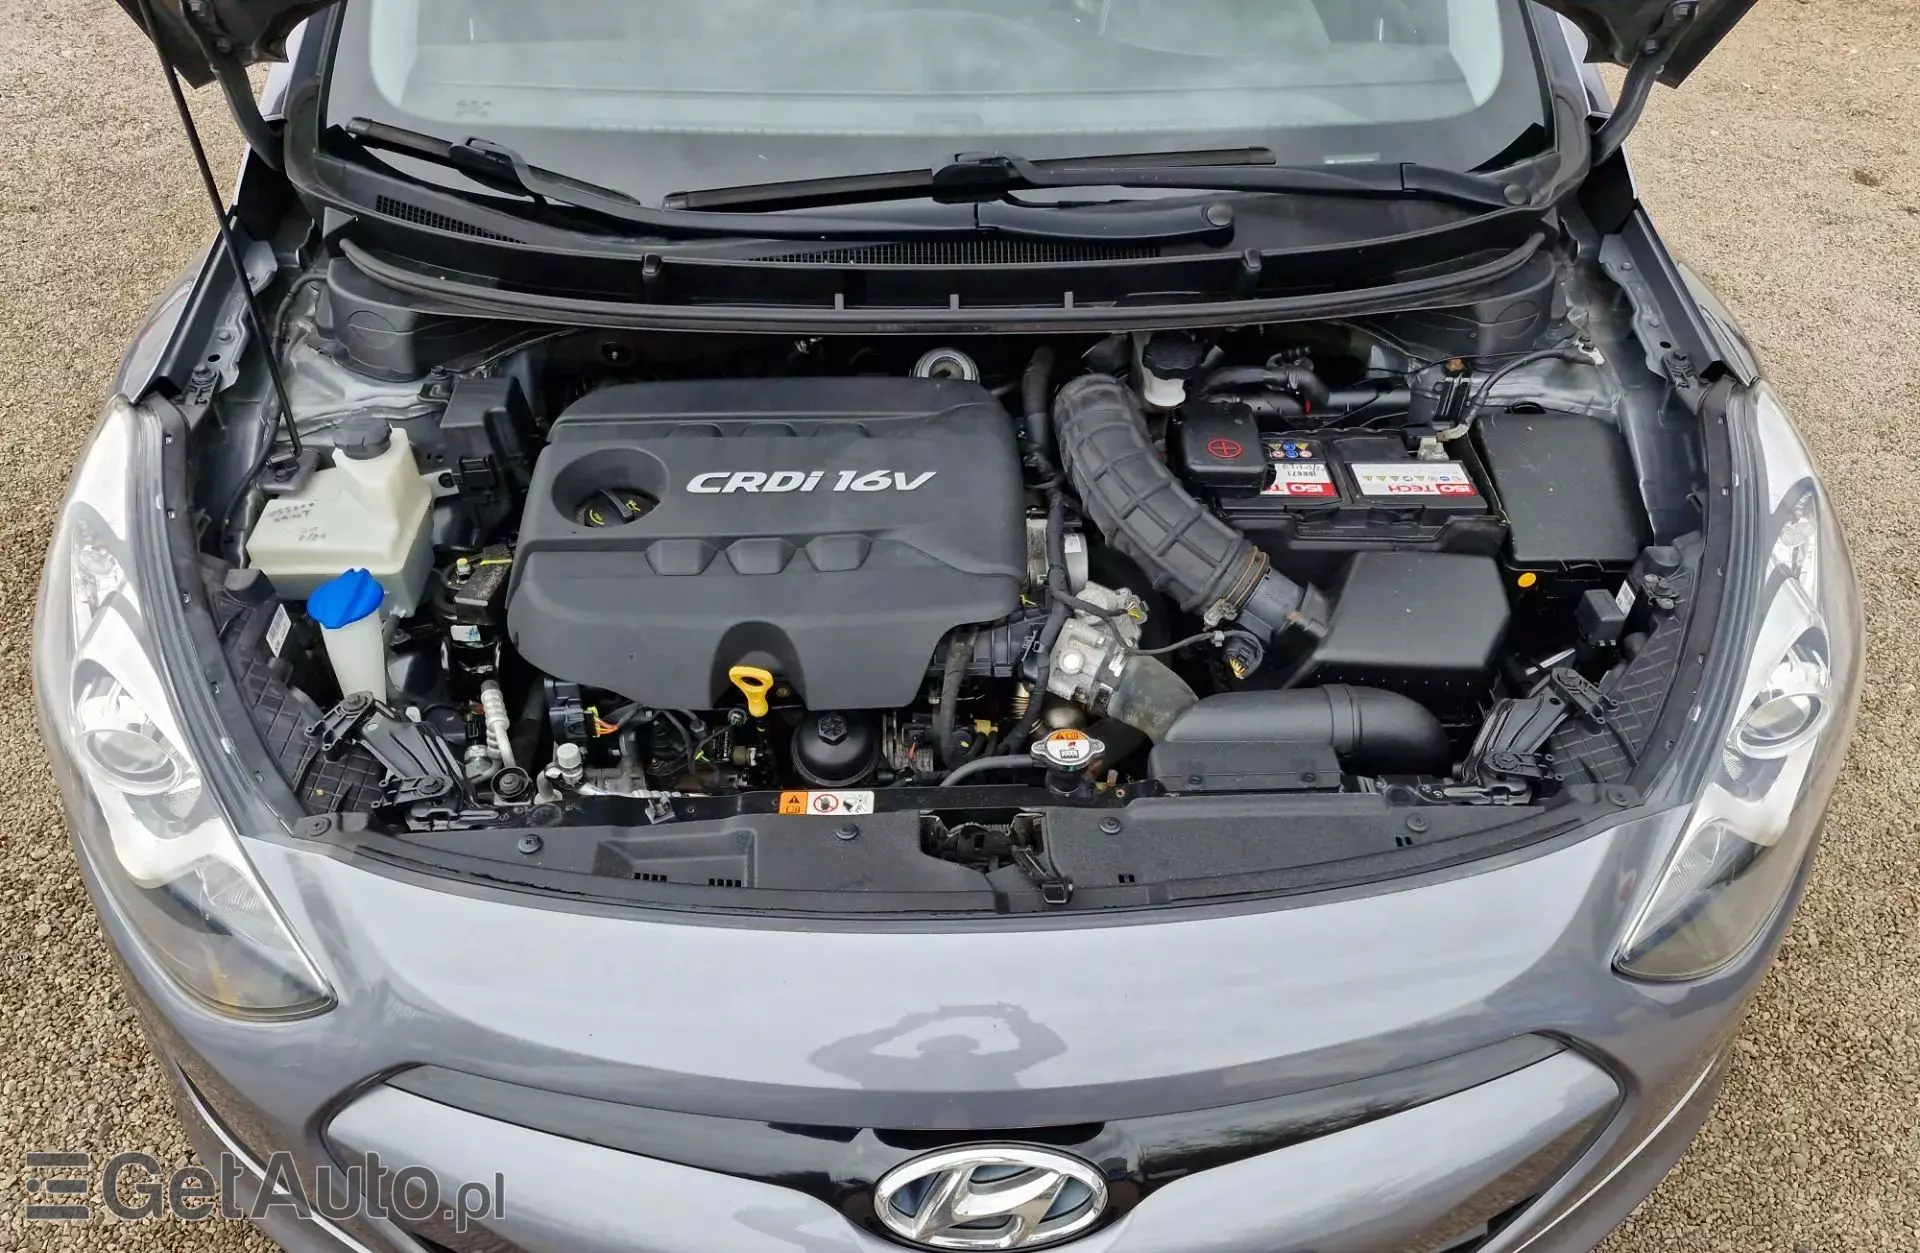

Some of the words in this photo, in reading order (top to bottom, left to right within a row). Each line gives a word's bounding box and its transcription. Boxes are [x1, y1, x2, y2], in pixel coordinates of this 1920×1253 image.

[687, 471, 825, 492] CRDi
[833, 470, 937, 491] 16V
[1290, 484, 1324, 493] ISO
[1440, 485, 1470, 493] ISO
